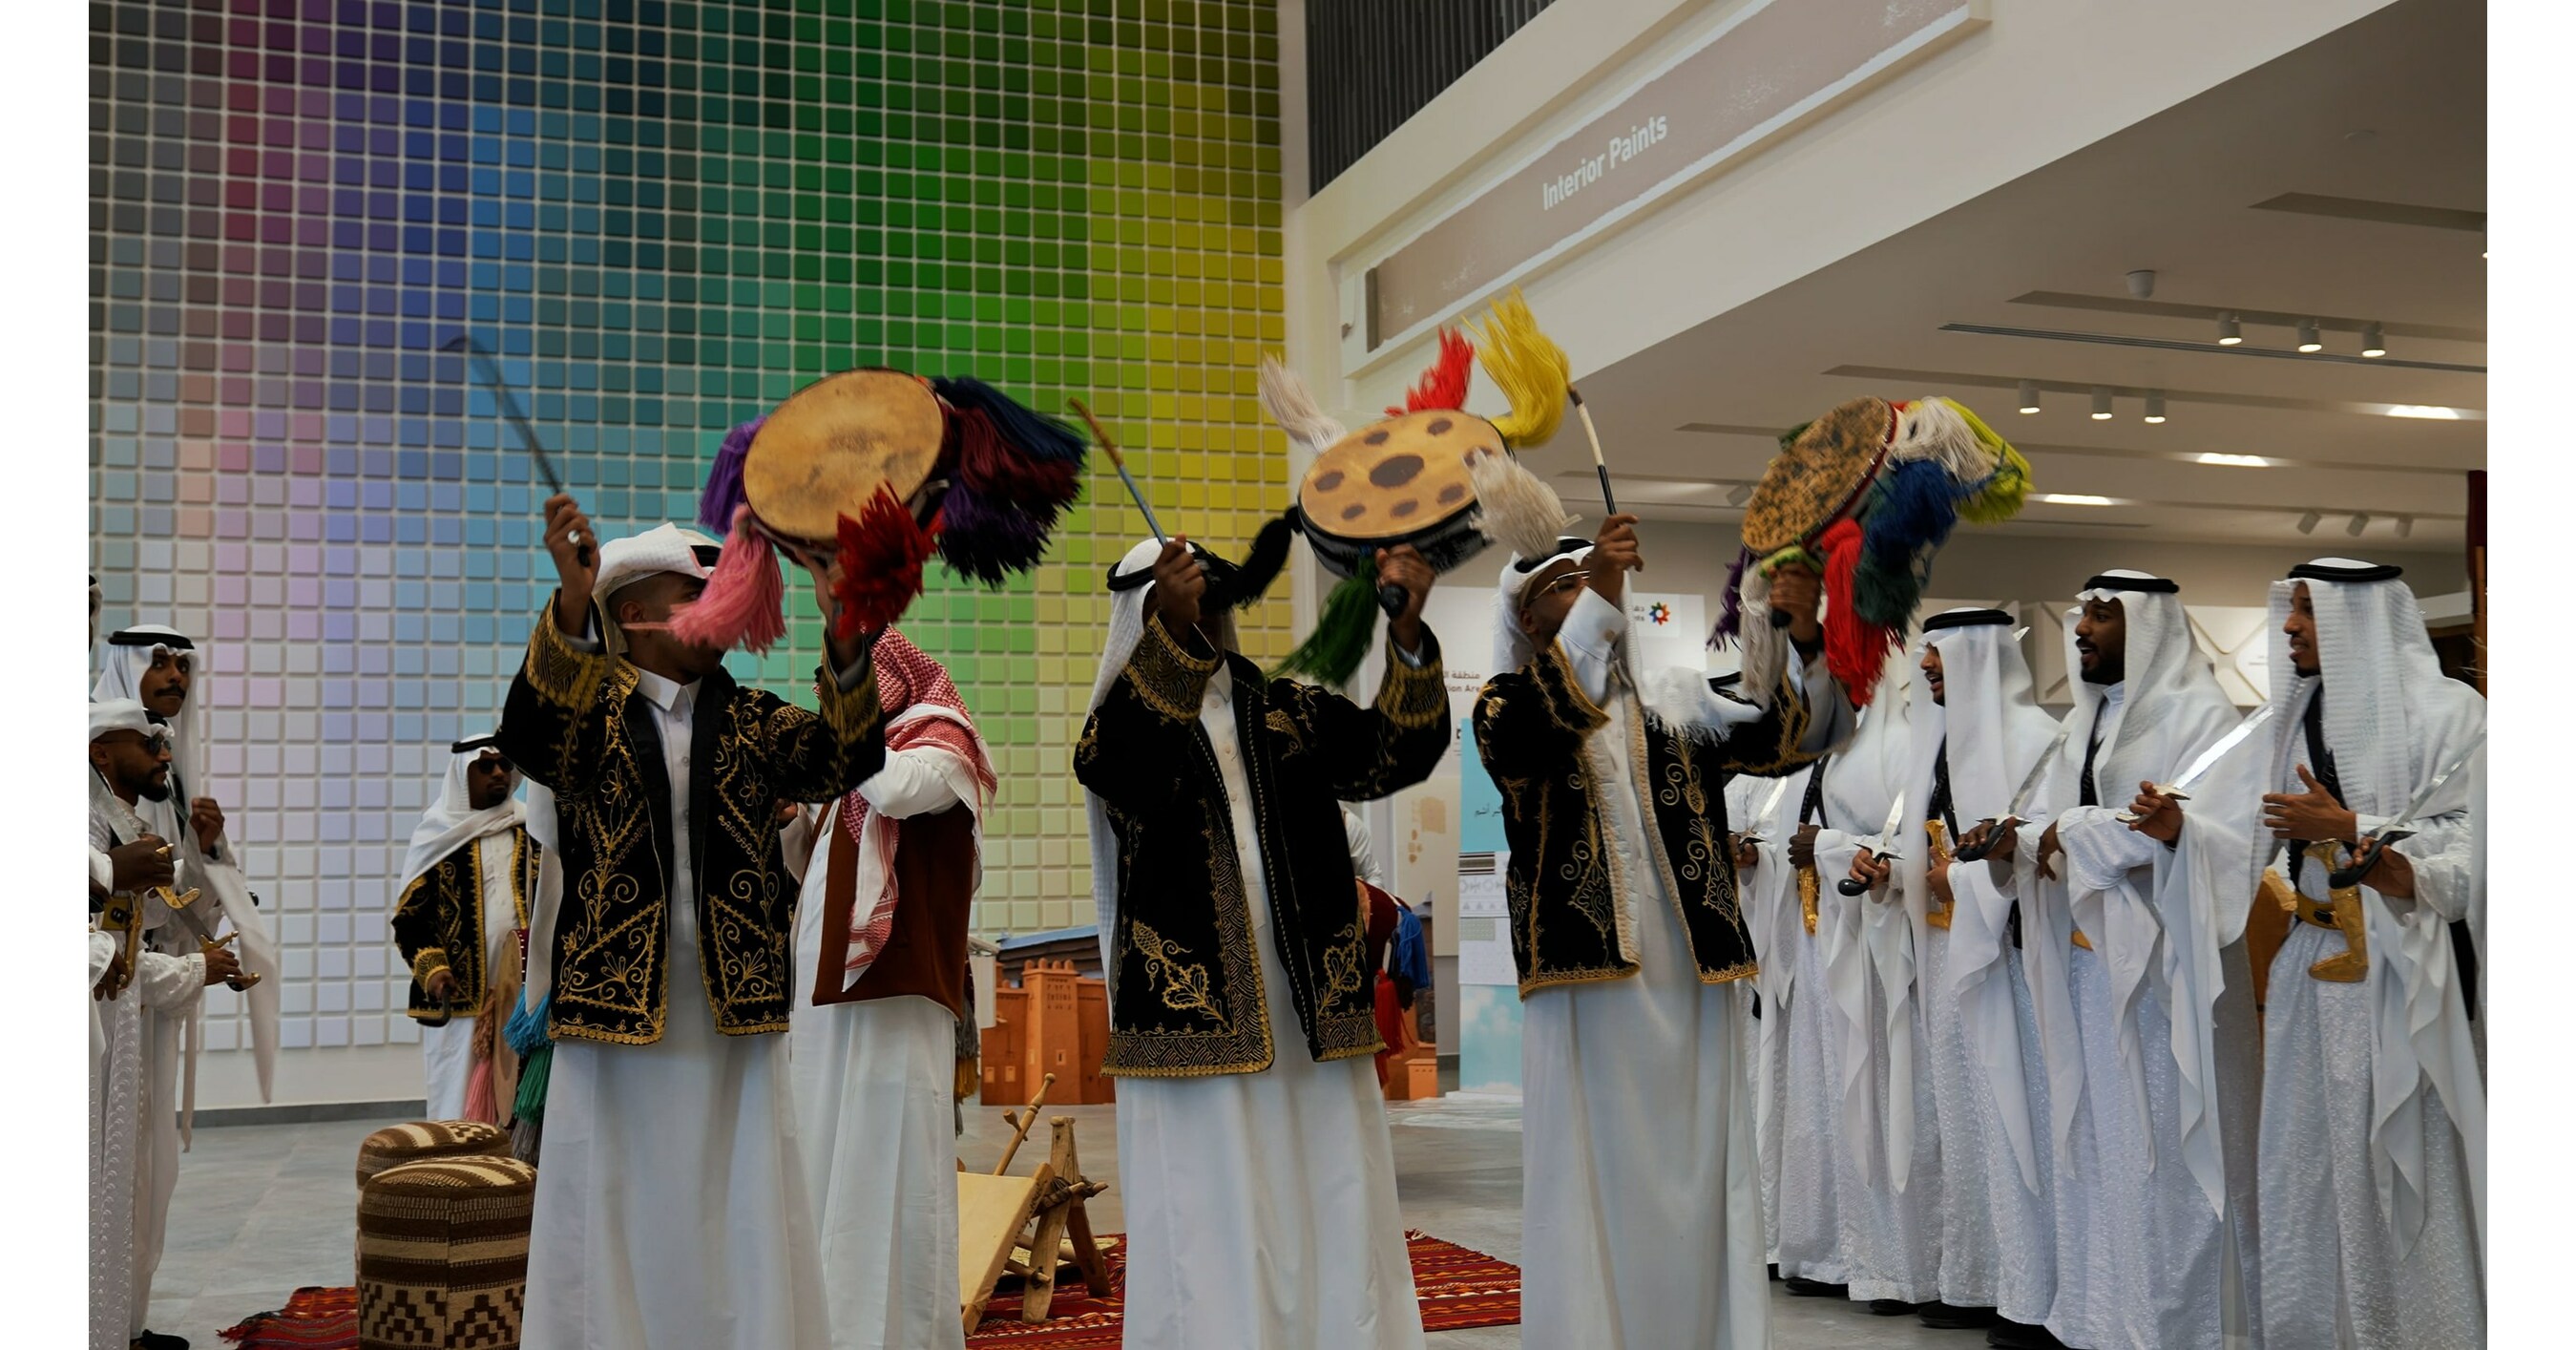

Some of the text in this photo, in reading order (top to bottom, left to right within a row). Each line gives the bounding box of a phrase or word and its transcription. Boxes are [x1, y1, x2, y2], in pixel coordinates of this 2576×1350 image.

[1542, 116, 1667, 211] Interior Paints
[1452, 669, 1481, 680] منطقة
